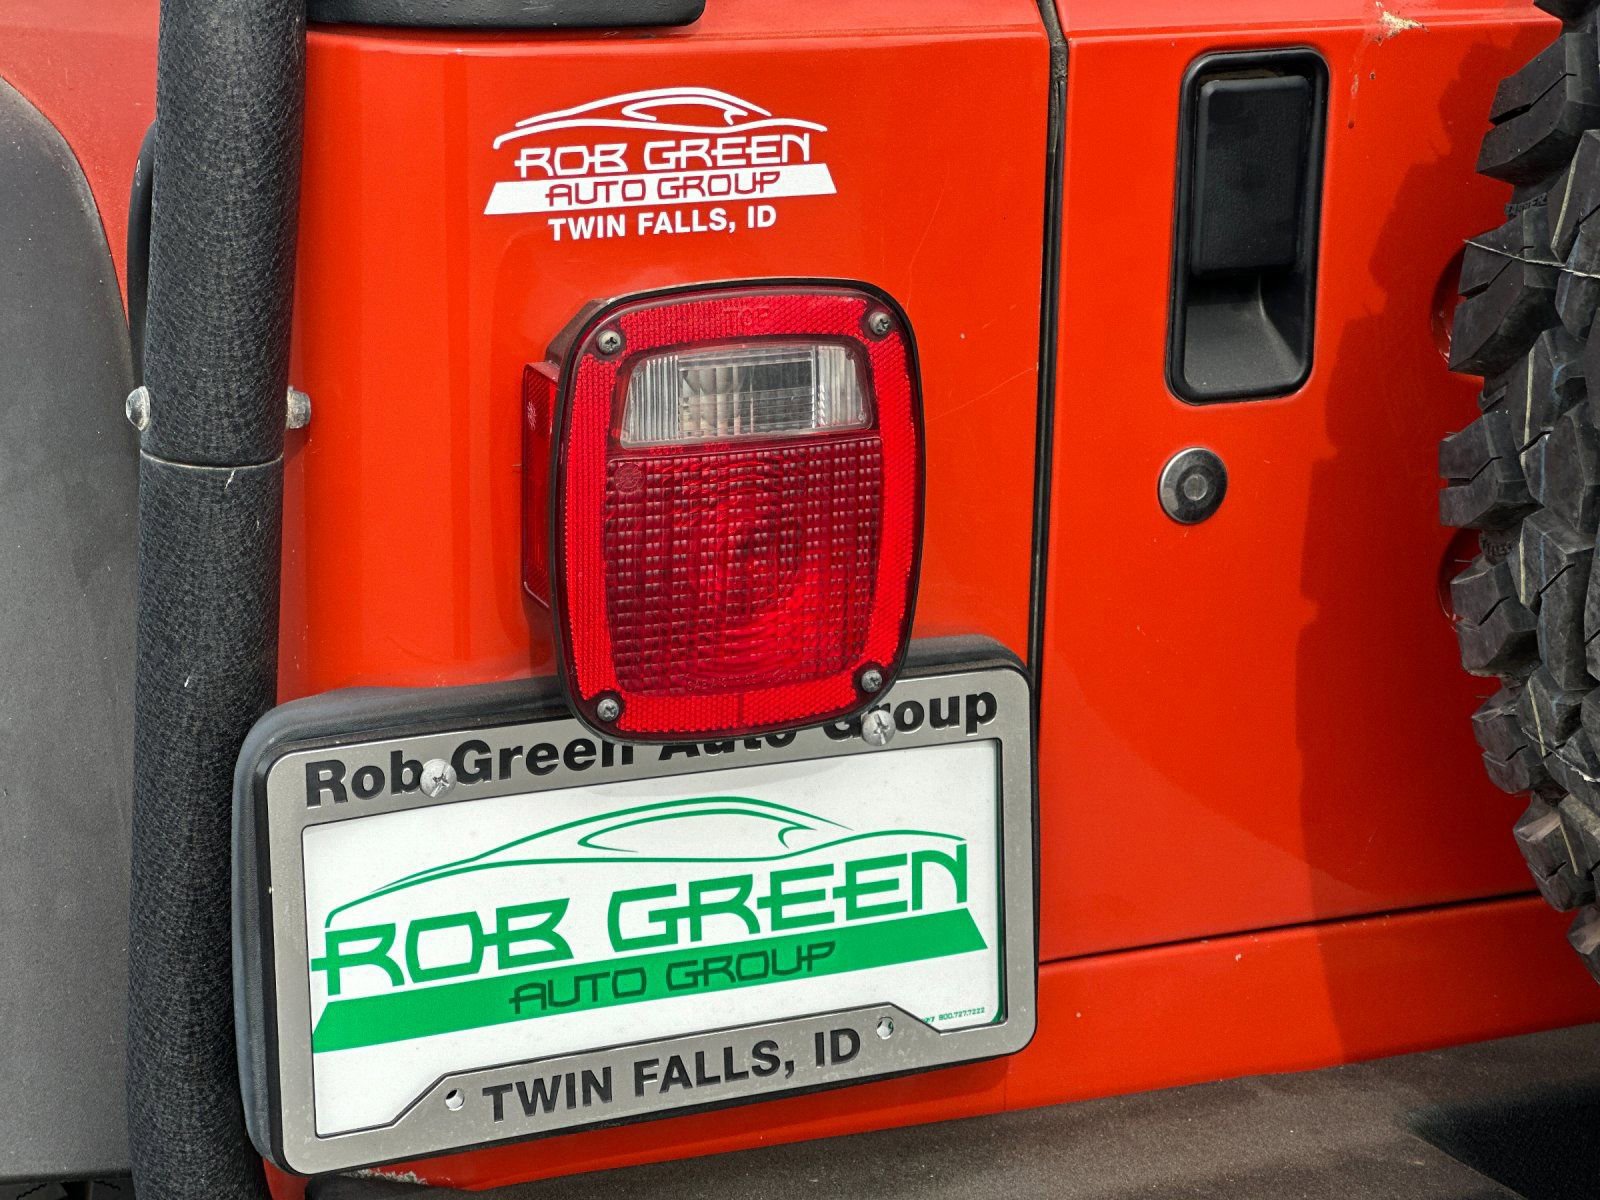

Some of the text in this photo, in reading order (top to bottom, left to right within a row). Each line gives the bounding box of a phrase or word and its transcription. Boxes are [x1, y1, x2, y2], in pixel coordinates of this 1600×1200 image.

[514, 133, 810, 178] ROB GREEN
[545, 171, 781, 206] AUTO GROUP
[548, 205, 777, 242] TWIN FALLS, ID
[305, 750, 424, 809] Rob
[310, 843, 967, 996] ROB GREEN
[508, 941, 838, 1015] AUTO GROUP
[482, 1027, 861, 1123] TWIN FALLS, ID
